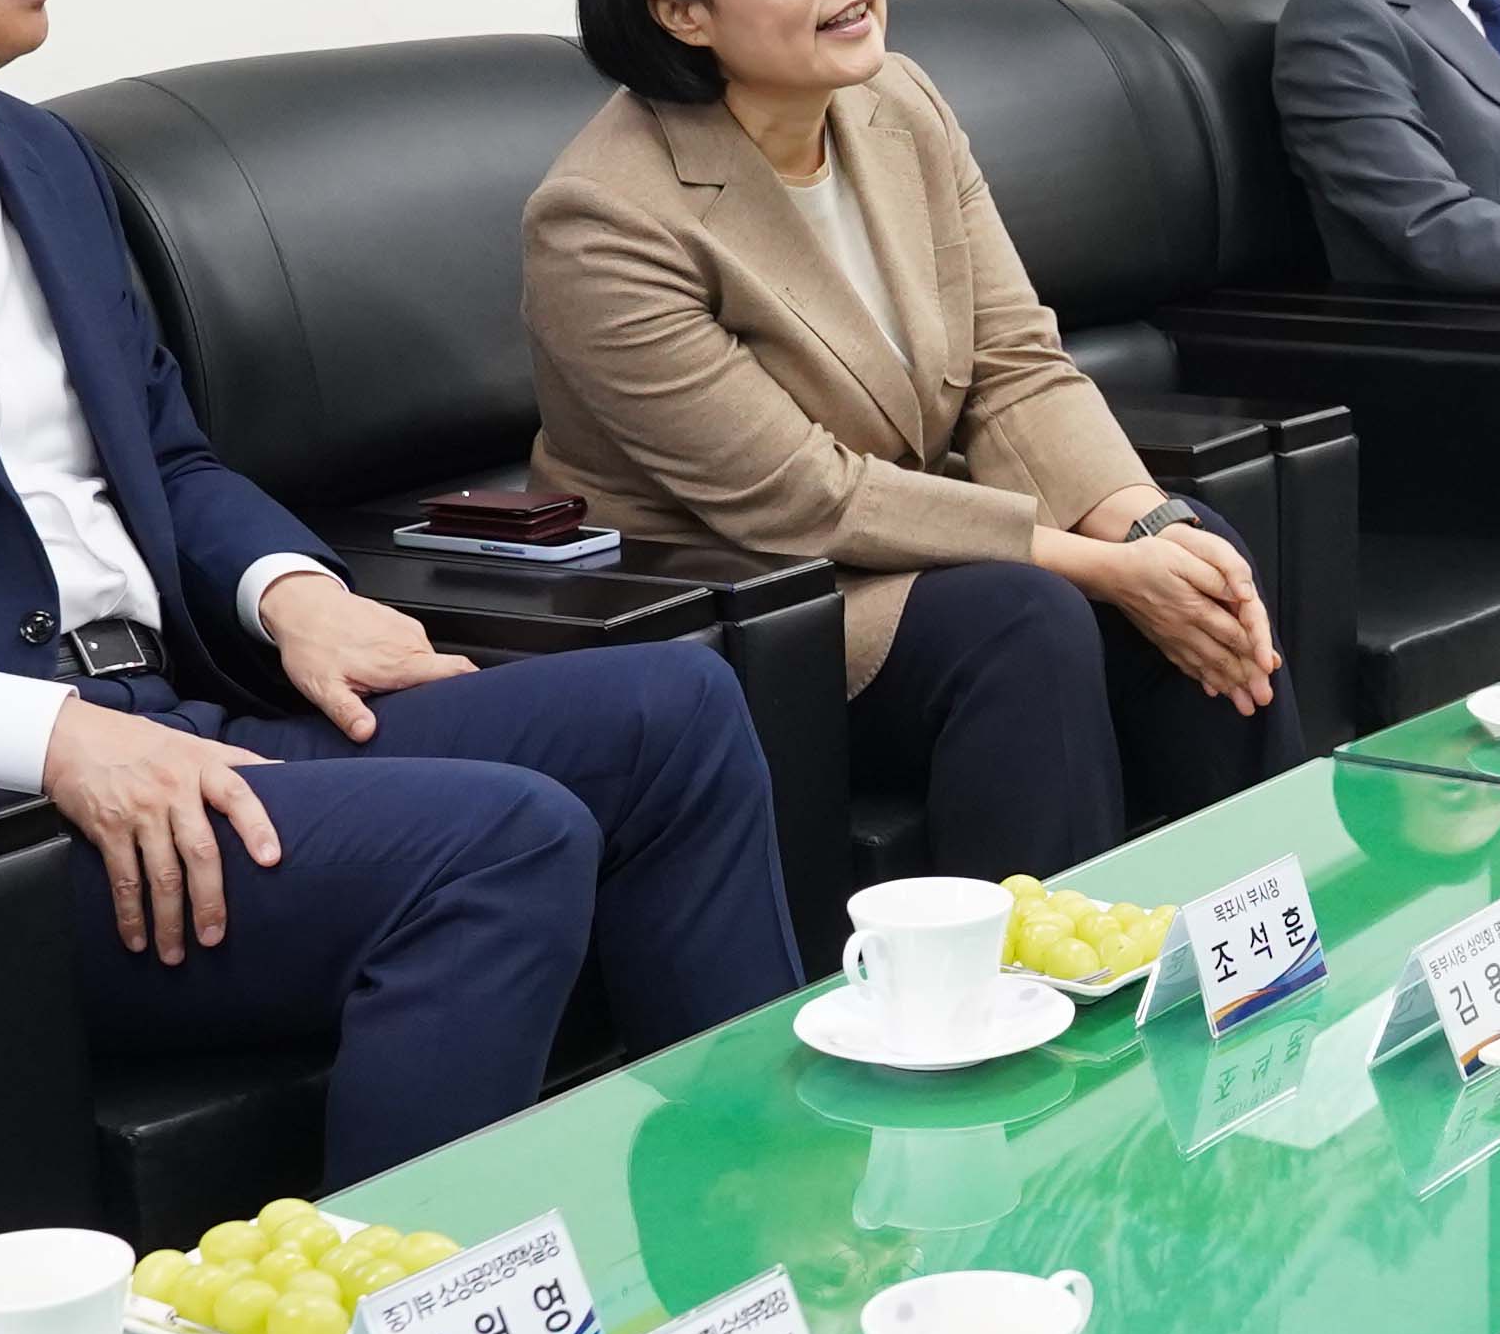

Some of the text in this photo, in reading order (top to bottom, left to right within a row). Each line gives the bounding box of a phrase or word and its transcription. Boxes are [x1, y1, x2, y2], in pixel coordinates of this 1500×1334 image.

[1213, 877, 1280, 922] 목포시 부시장
[1428, 943, 1468, 980] 동부시장
[1467, 928, 1495, 957] 상인회
[382, 1290, 436, 1333] 중기부
